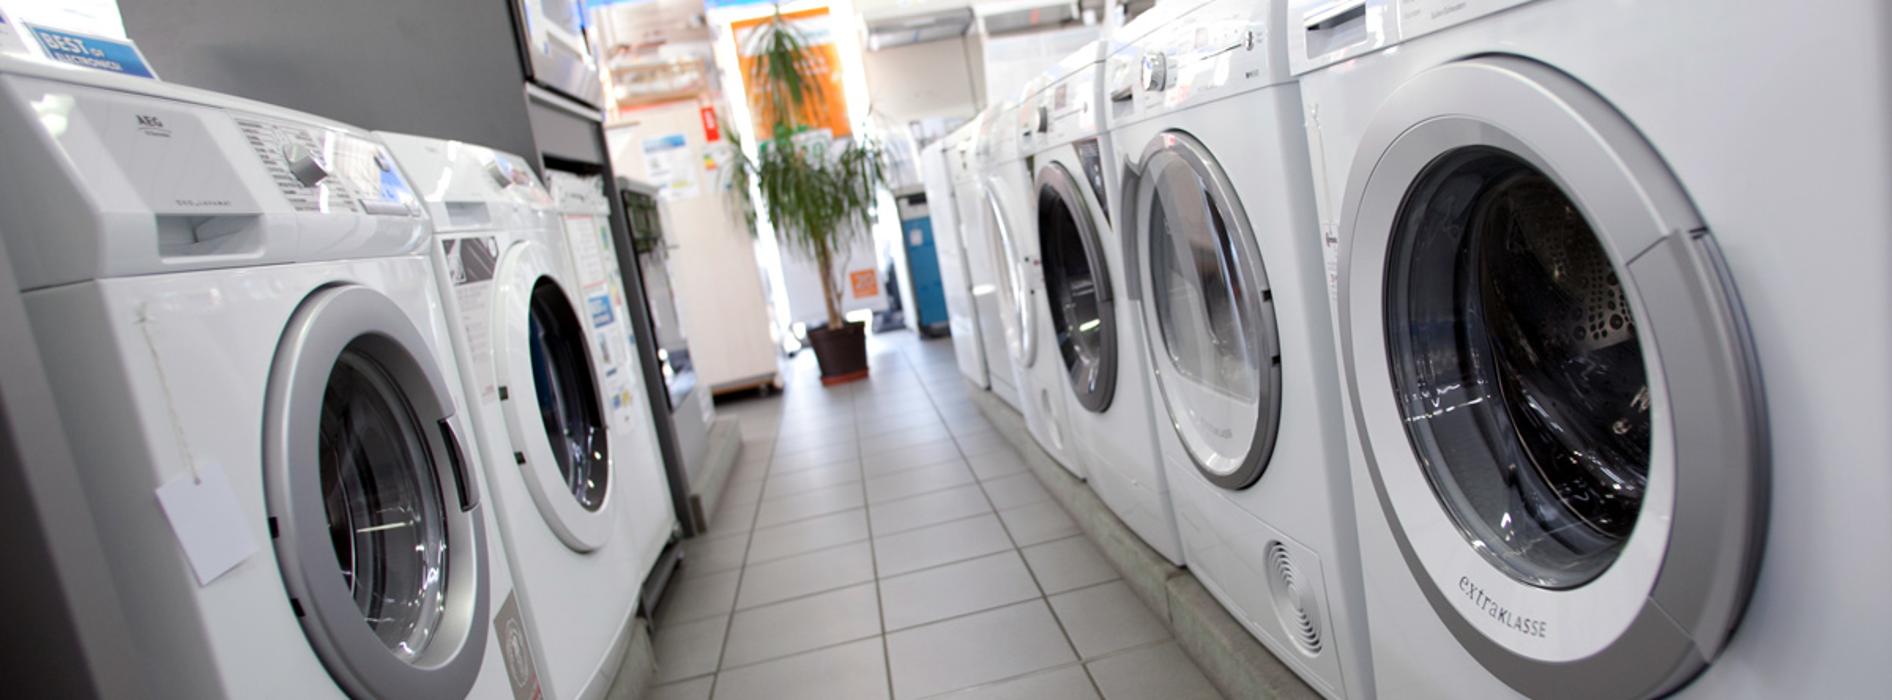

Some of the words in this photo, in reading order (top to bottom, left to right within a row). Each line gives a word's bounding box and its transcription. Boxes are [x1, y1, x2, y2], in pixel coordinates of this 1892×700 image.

[41, 32, 89, 55] BEST
[136, 114, 164, 128] AEG
[1459, 575, 1547, 638] extraKLASSE
